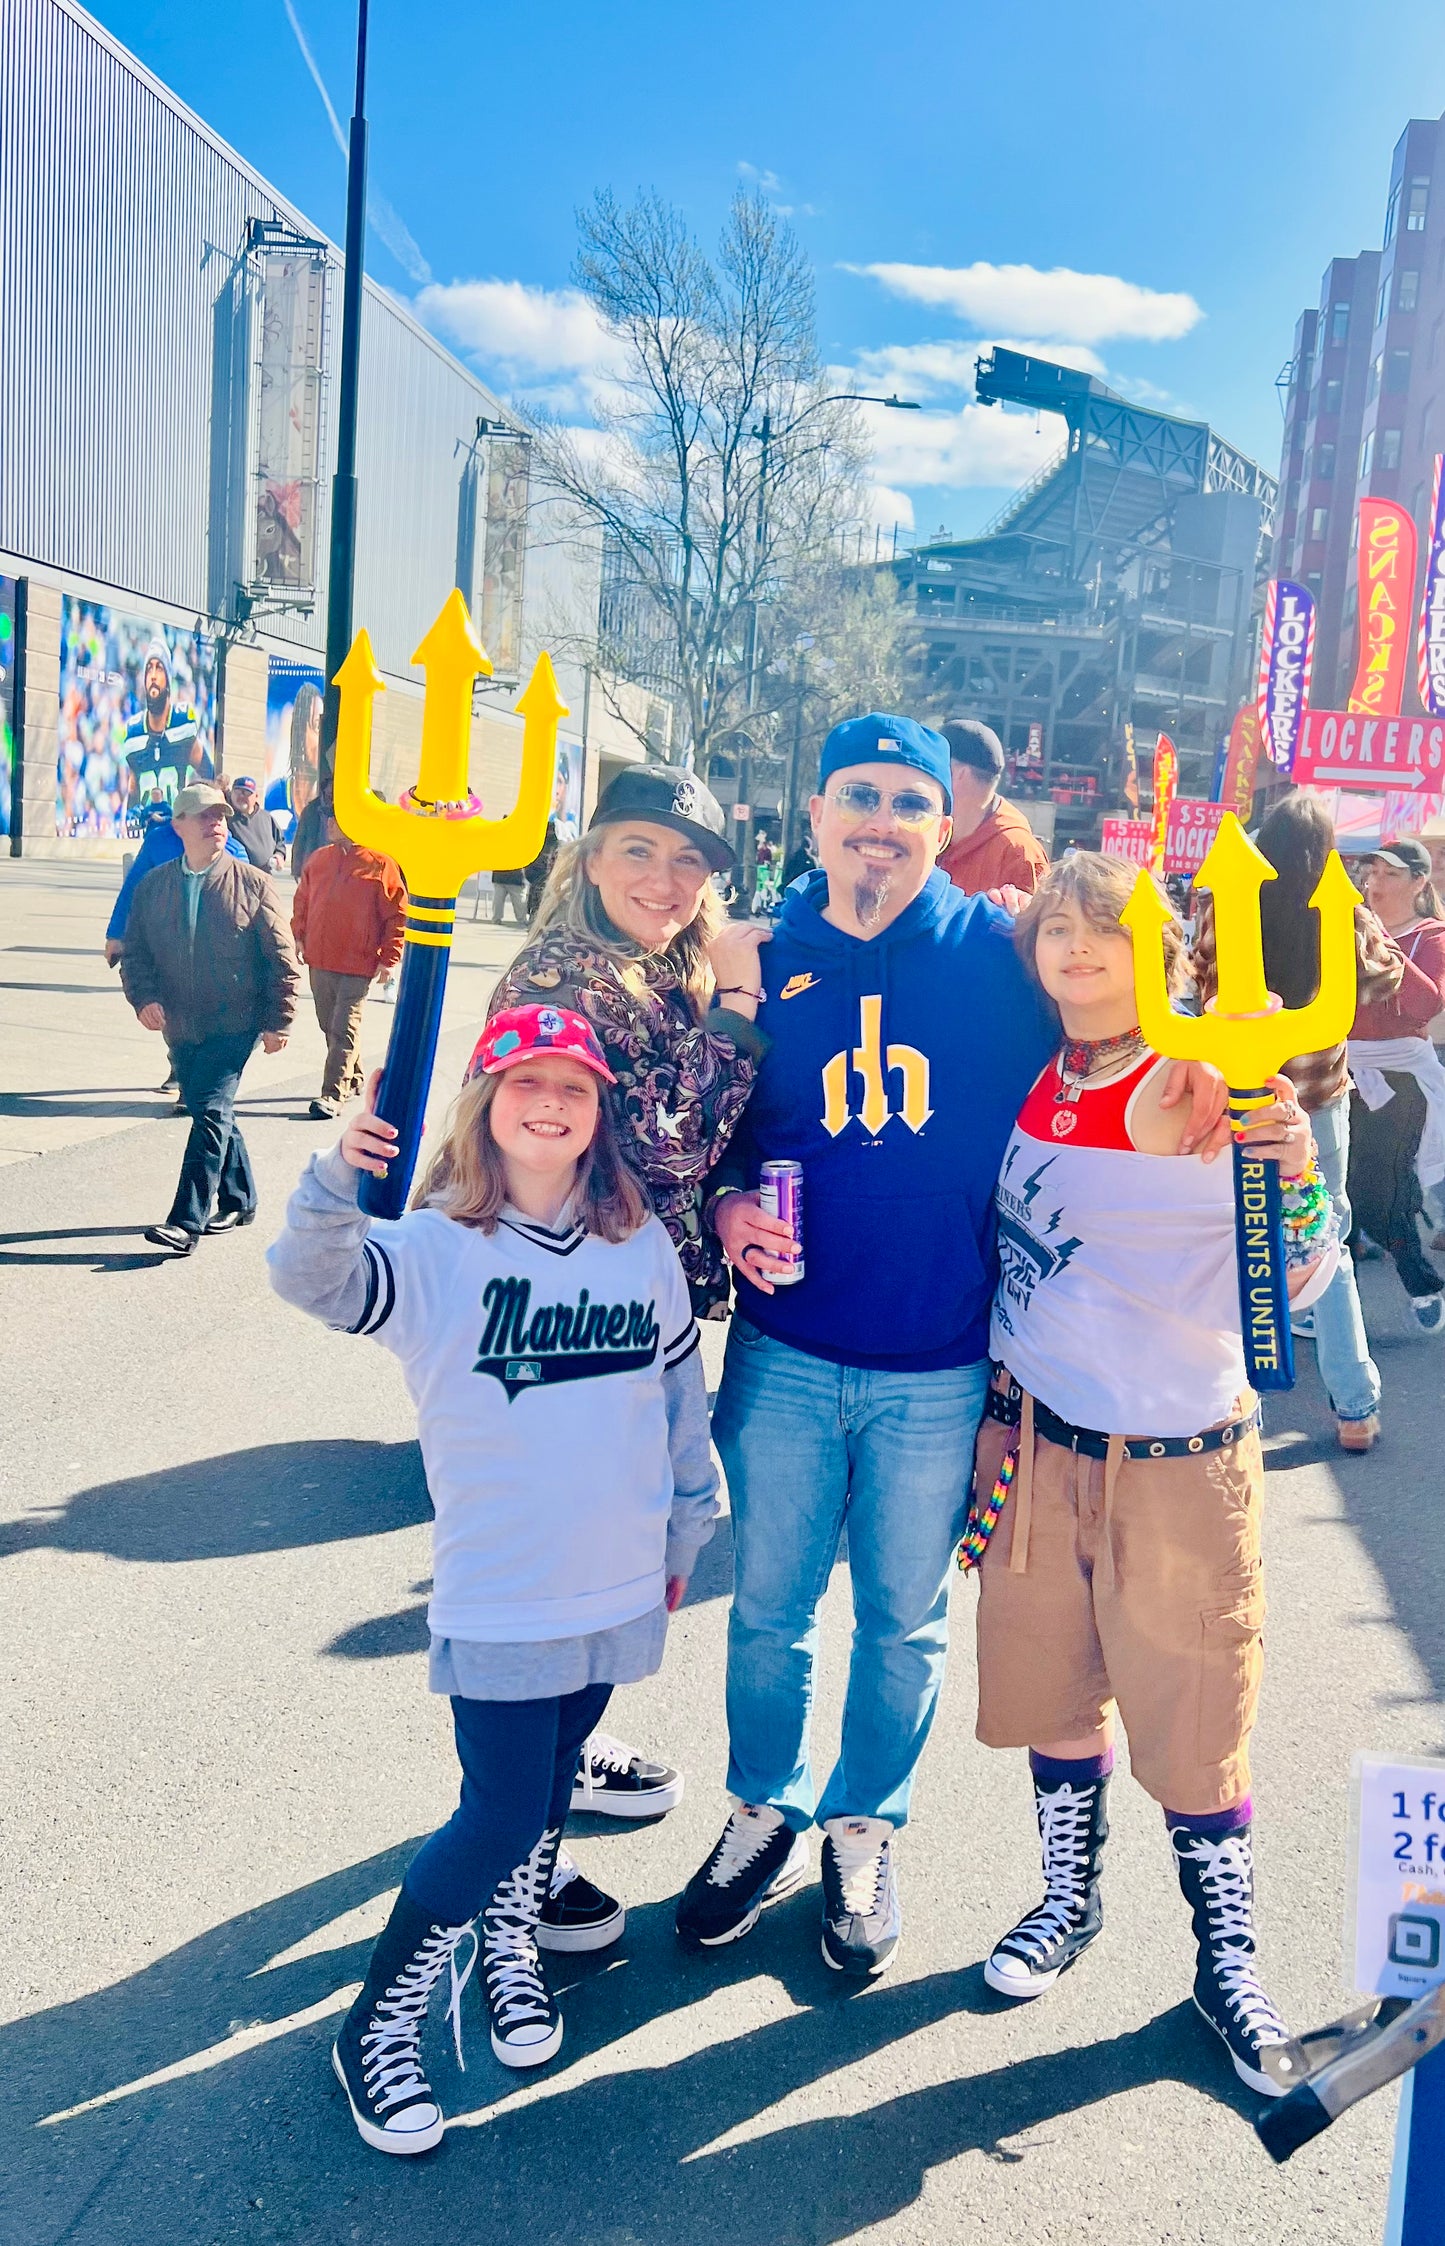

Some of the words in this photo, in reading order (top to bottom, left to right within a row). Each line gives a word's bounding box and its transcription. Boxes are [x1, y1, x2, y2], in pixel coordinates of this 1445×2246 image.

[1271, 597, 1305, 764] LOCKERS
[1300, 717, 1443, 768] LOCKERS
[1180, 805, 1206, 825] $5
[1166, 825, 1216, 858] LOCKE
[787, 972, 813, 989] NIKE
[1241, 1160, 1272, 1278] RIDENTS
[478, 1275, 660, 1356] Mariners
[1250, 1287, 1278, 1370] UNITE
[1392, 1791, 1411, 1819] 1
[1393, 1831, 1412, 1860] 2
[1398, 1862, 1438, 1878] Cash,
